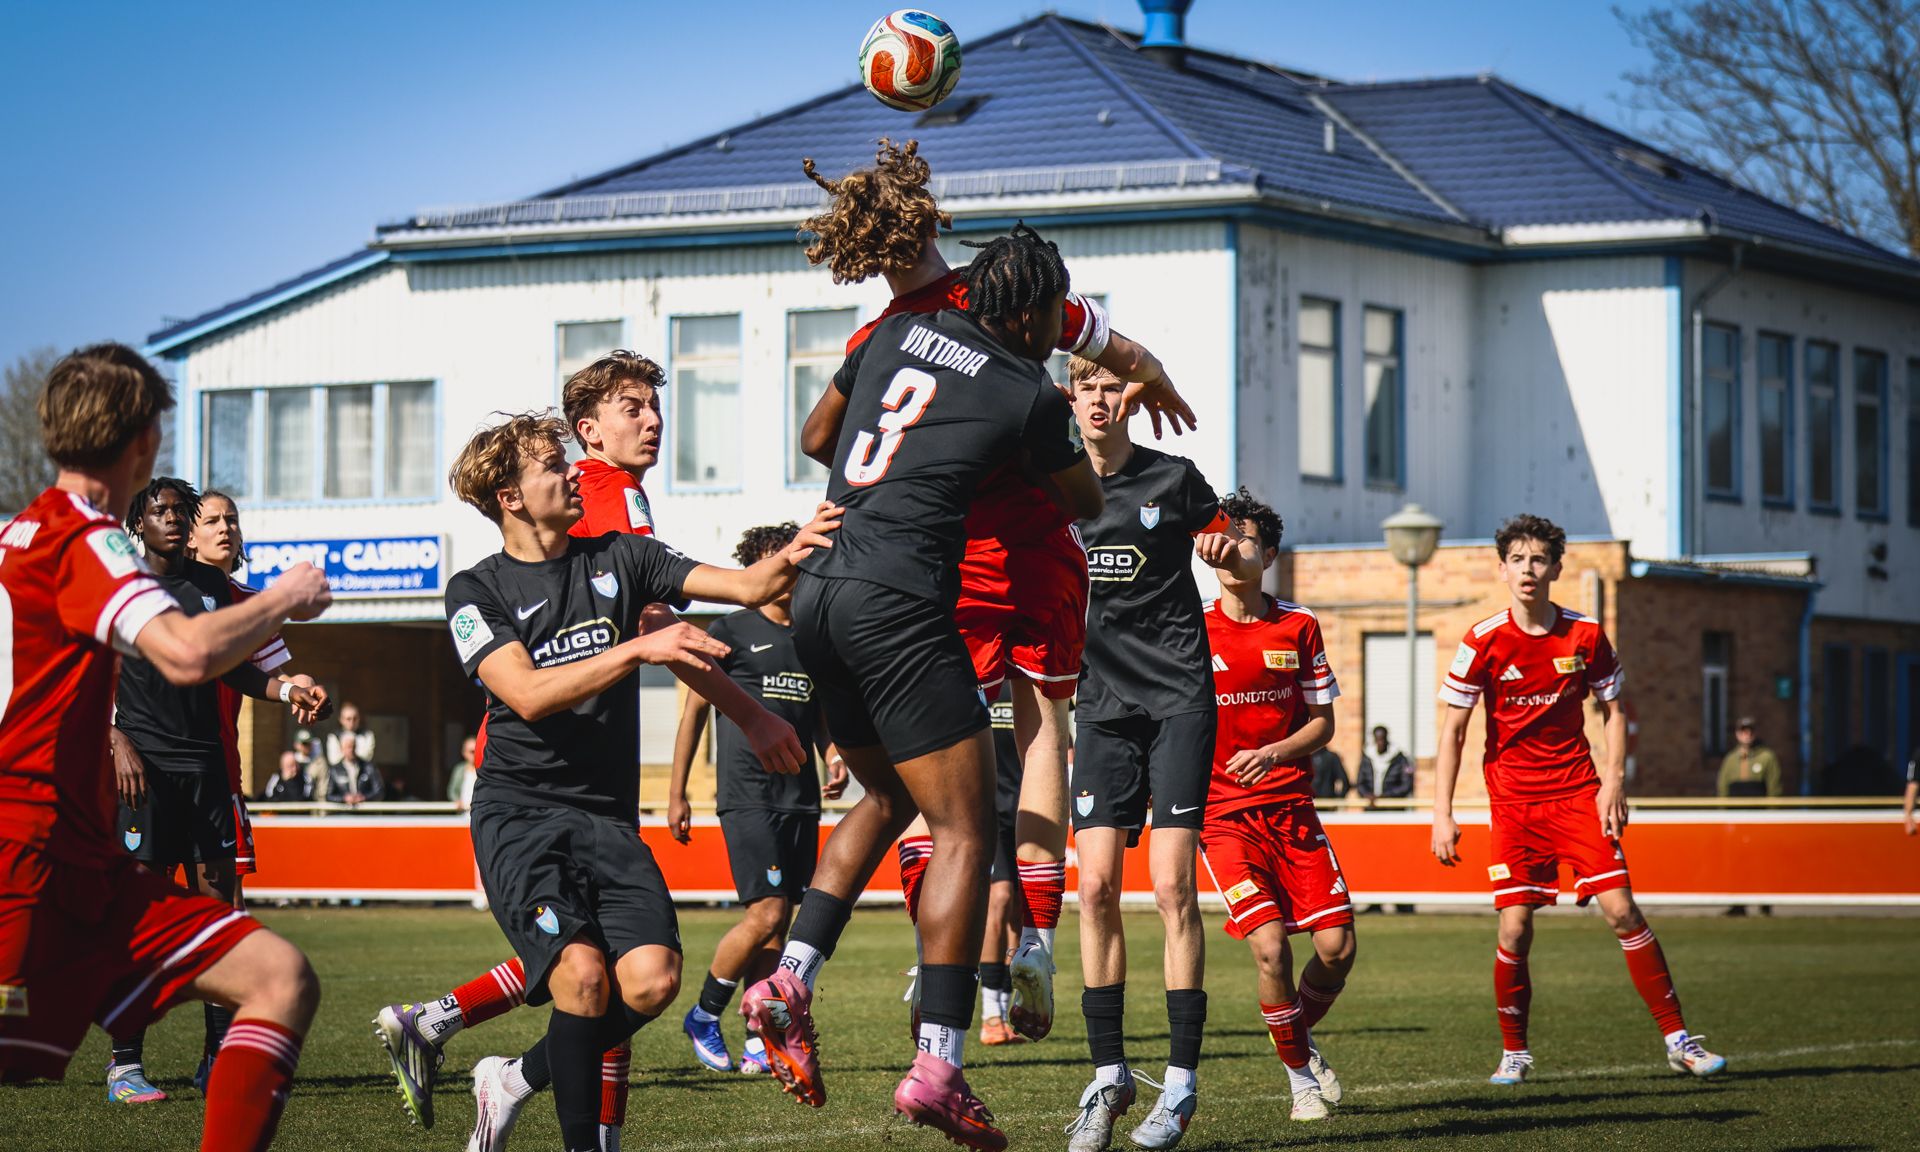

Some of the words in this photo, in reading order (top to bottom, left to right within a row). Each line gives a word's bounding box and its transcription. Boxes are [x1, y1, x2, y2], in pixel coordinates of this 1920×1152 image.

[900, 324, 990, 378] VIKTORIA
[844, 366, 937, 487] 3
[342, 540, 439, 571] CASINO
[1088, 553, 1132, 566] UGO
[534, 628, 611, 661] HUGO
[762, 675, 808, 691] HUGO
[1215, 685, 1294, 706] ROUNDTOWN
